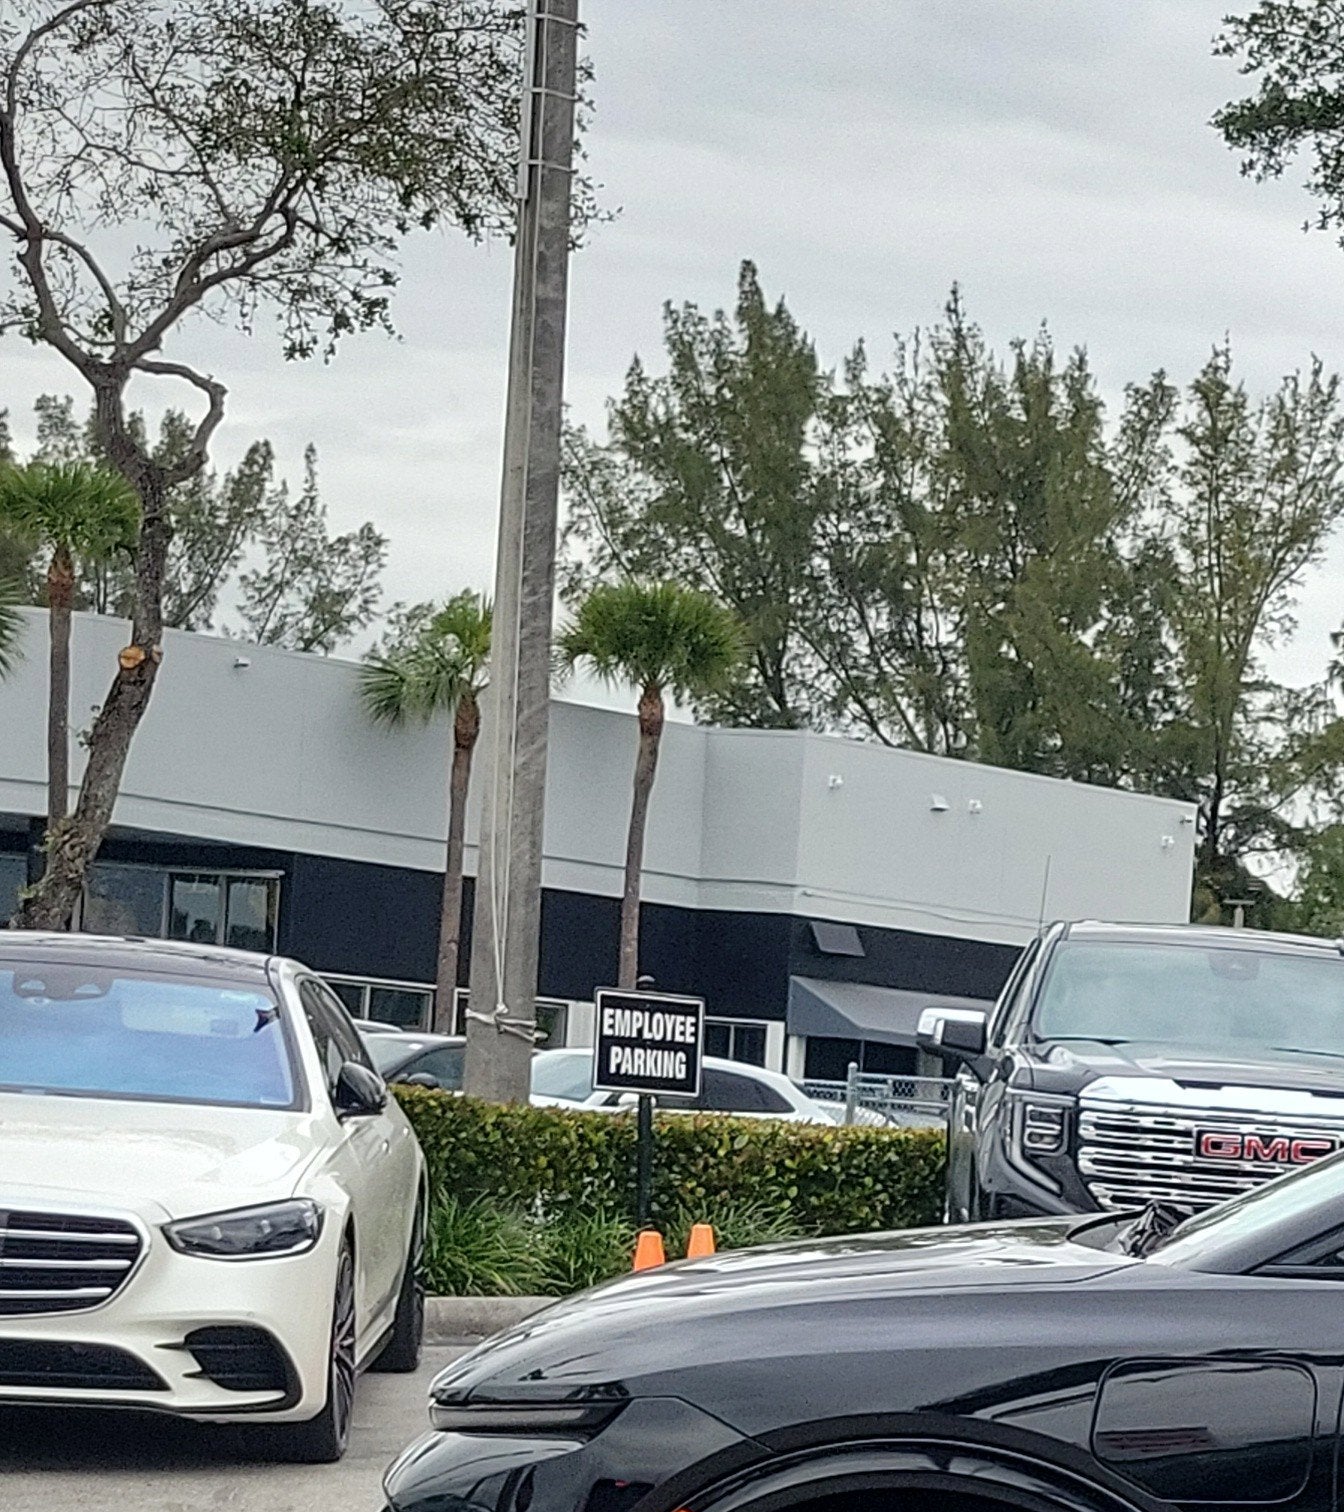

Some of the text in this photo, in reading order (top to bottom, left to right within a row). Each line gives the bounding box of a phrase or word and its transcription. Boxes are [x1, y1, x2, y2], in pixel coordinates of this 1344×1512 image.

[602, 1007, 697, 1043] EMPLOYEE
[609, 1045, 687, 1079] PARKING
[1201, 1133, 1332, 1164] GMC
